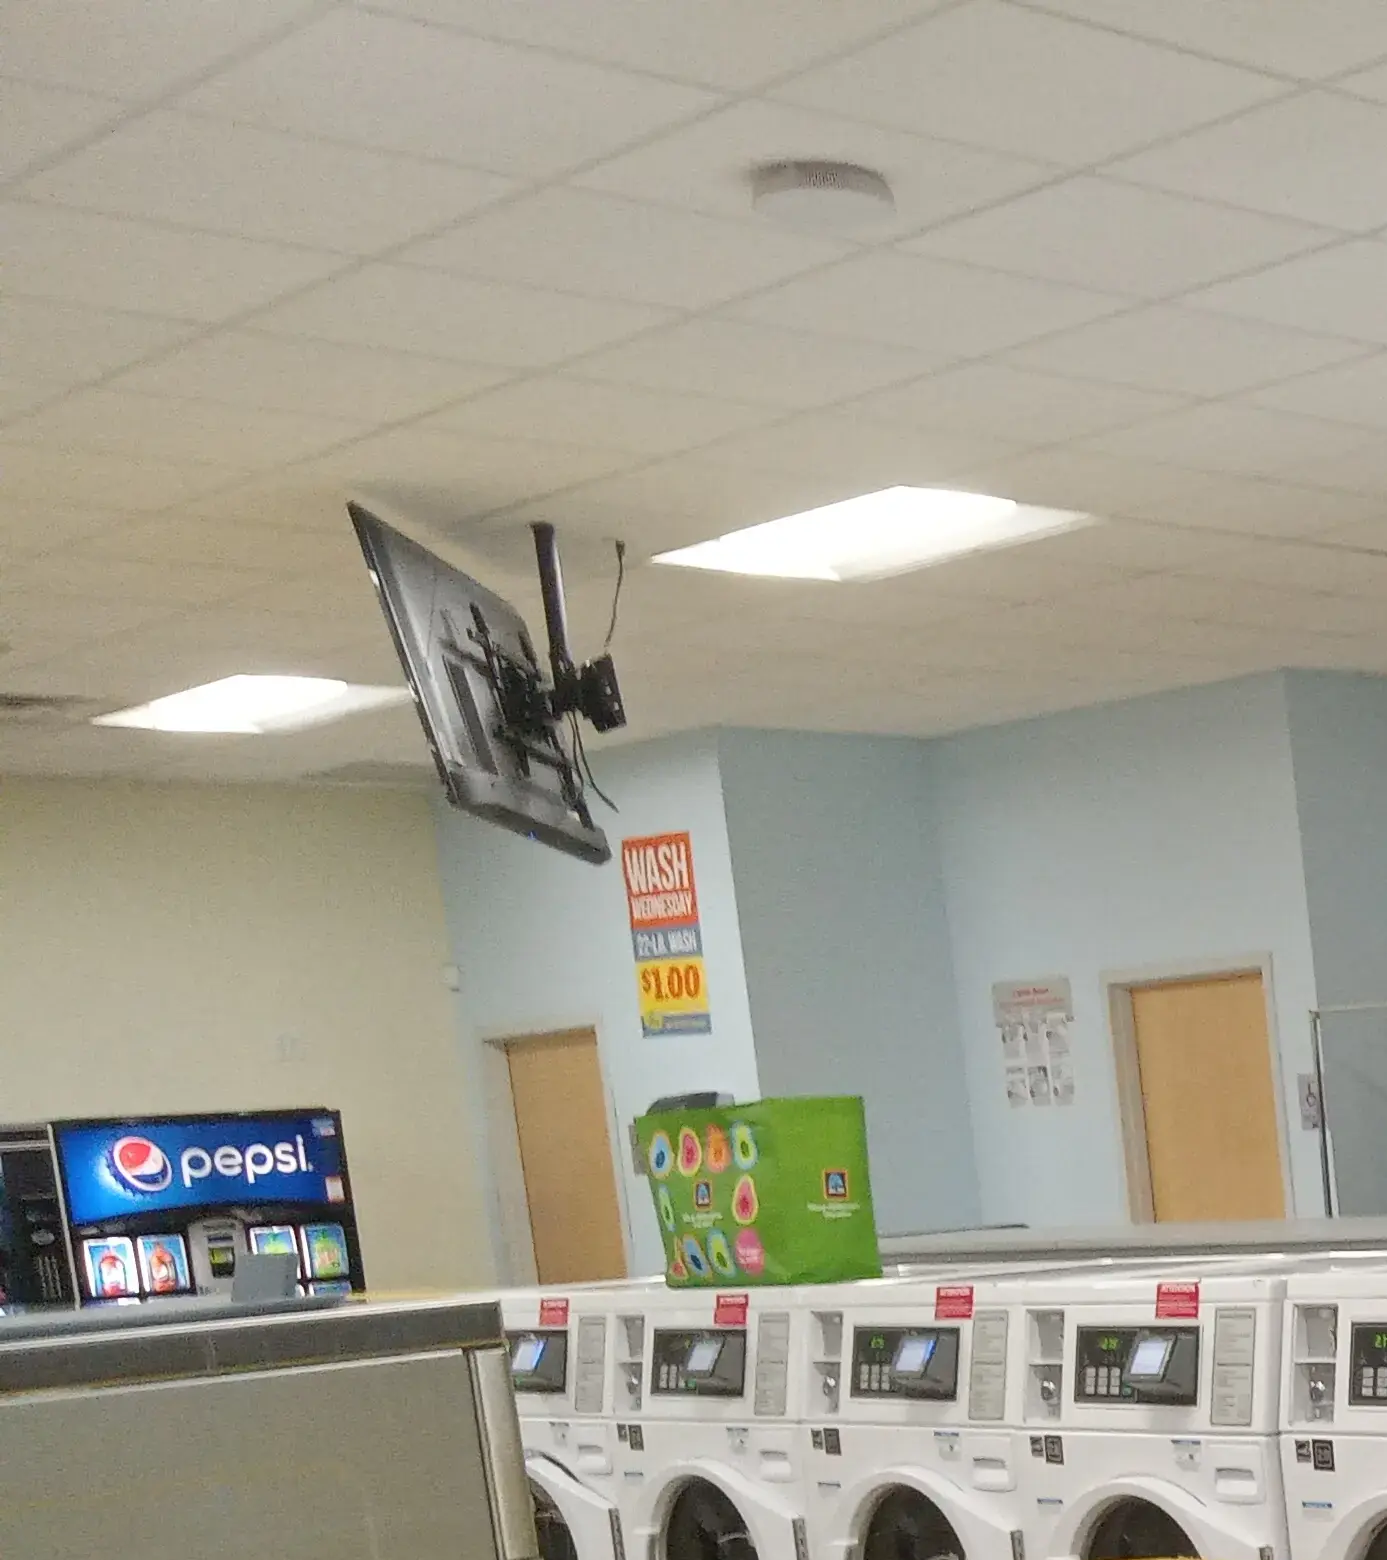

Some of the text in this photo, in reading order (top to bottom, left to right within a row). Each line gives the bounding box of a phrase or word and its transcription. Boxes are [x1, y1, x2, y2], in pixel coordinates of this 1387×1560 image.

[624, 841, 689, 895] WASH
[641, 964, 700, 1002] $1.00
[180, 1134, 309, 1188] pepsi
